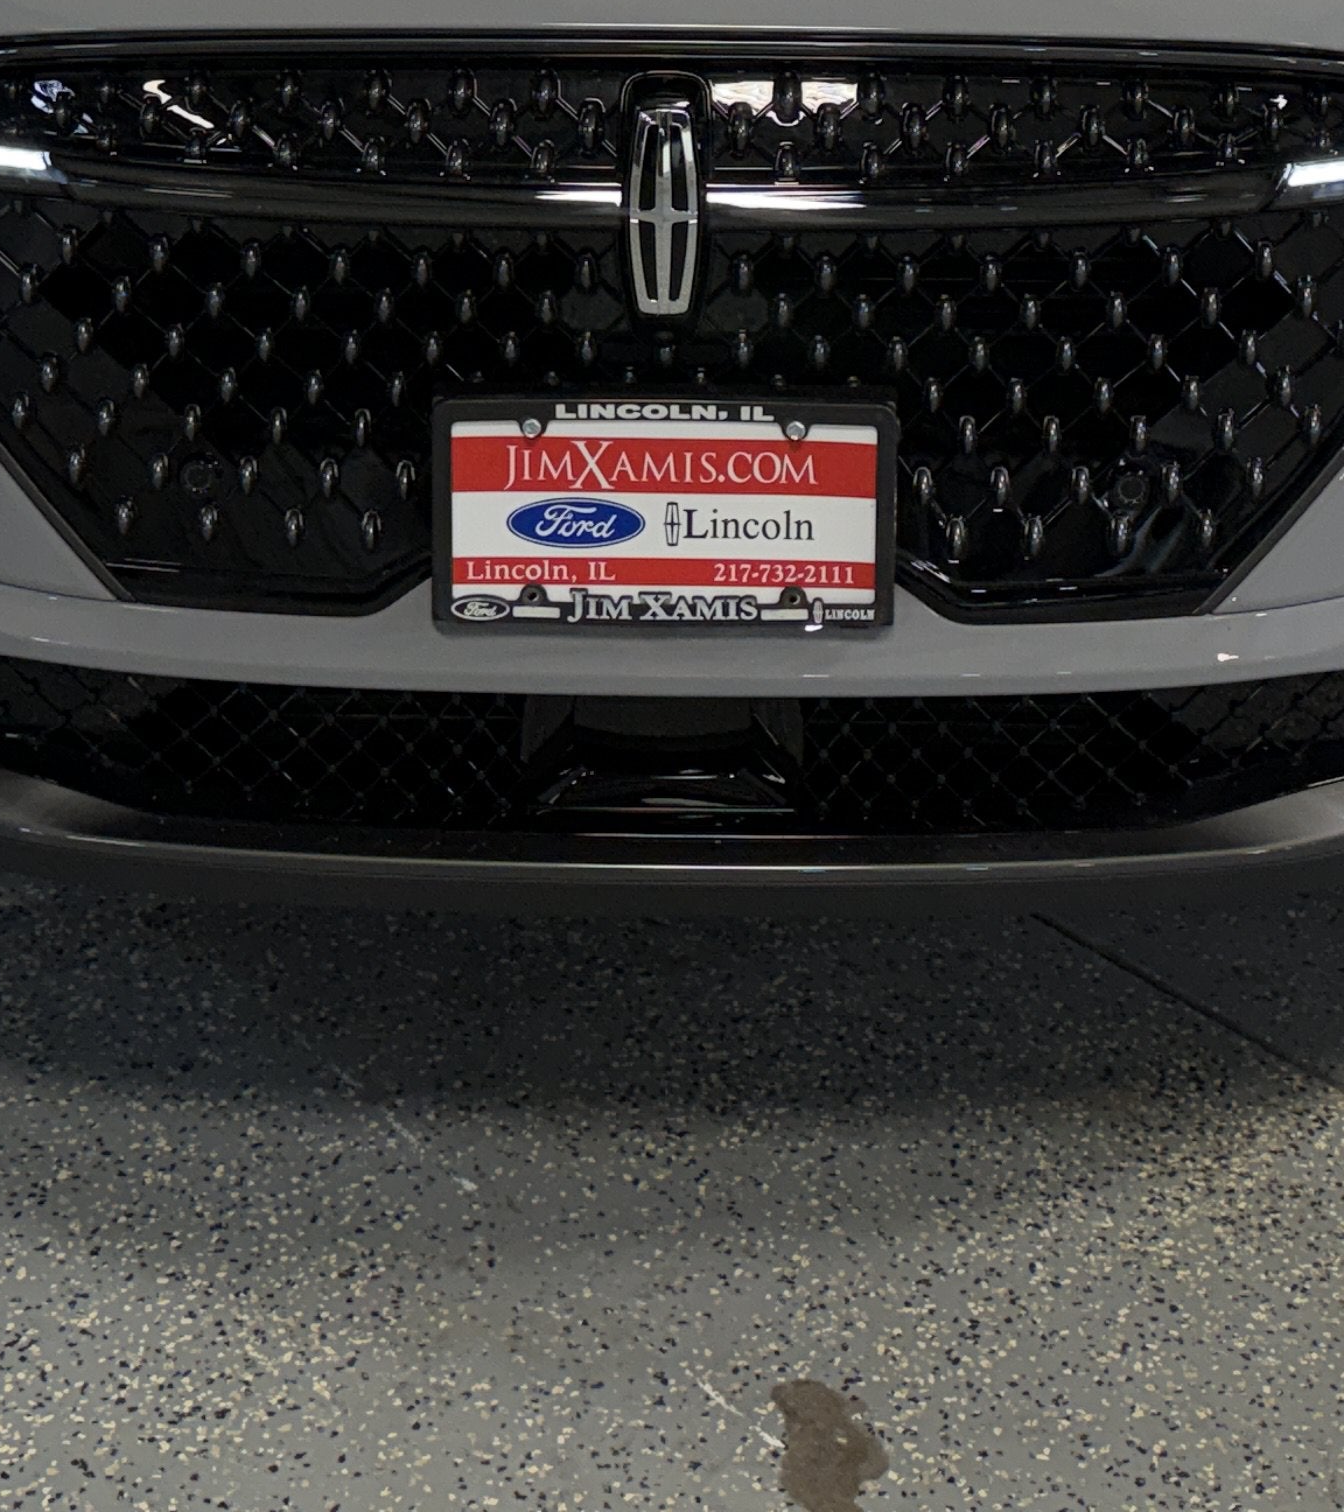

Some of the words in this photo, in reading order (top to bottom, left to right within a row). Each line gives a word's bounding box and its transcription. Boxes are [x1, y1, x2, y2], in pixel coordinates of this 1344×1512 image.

[555, 403, 728, 420] LINCOLN,
[740, 406, 775, 421] IL
[536, 504, 616, 539] Ford
[683, 508, 814, 541] Lincoln
[467, 561, 577, 583] Lincoln,
[589, 562, 616, 581] IL
[714, 563, 854, 583] 217-732-2111
[567, 589, 632, 623] JIM
[639, 594, 758, 621] XAMIS
[825, 608, 875, 621] LINCOLN
